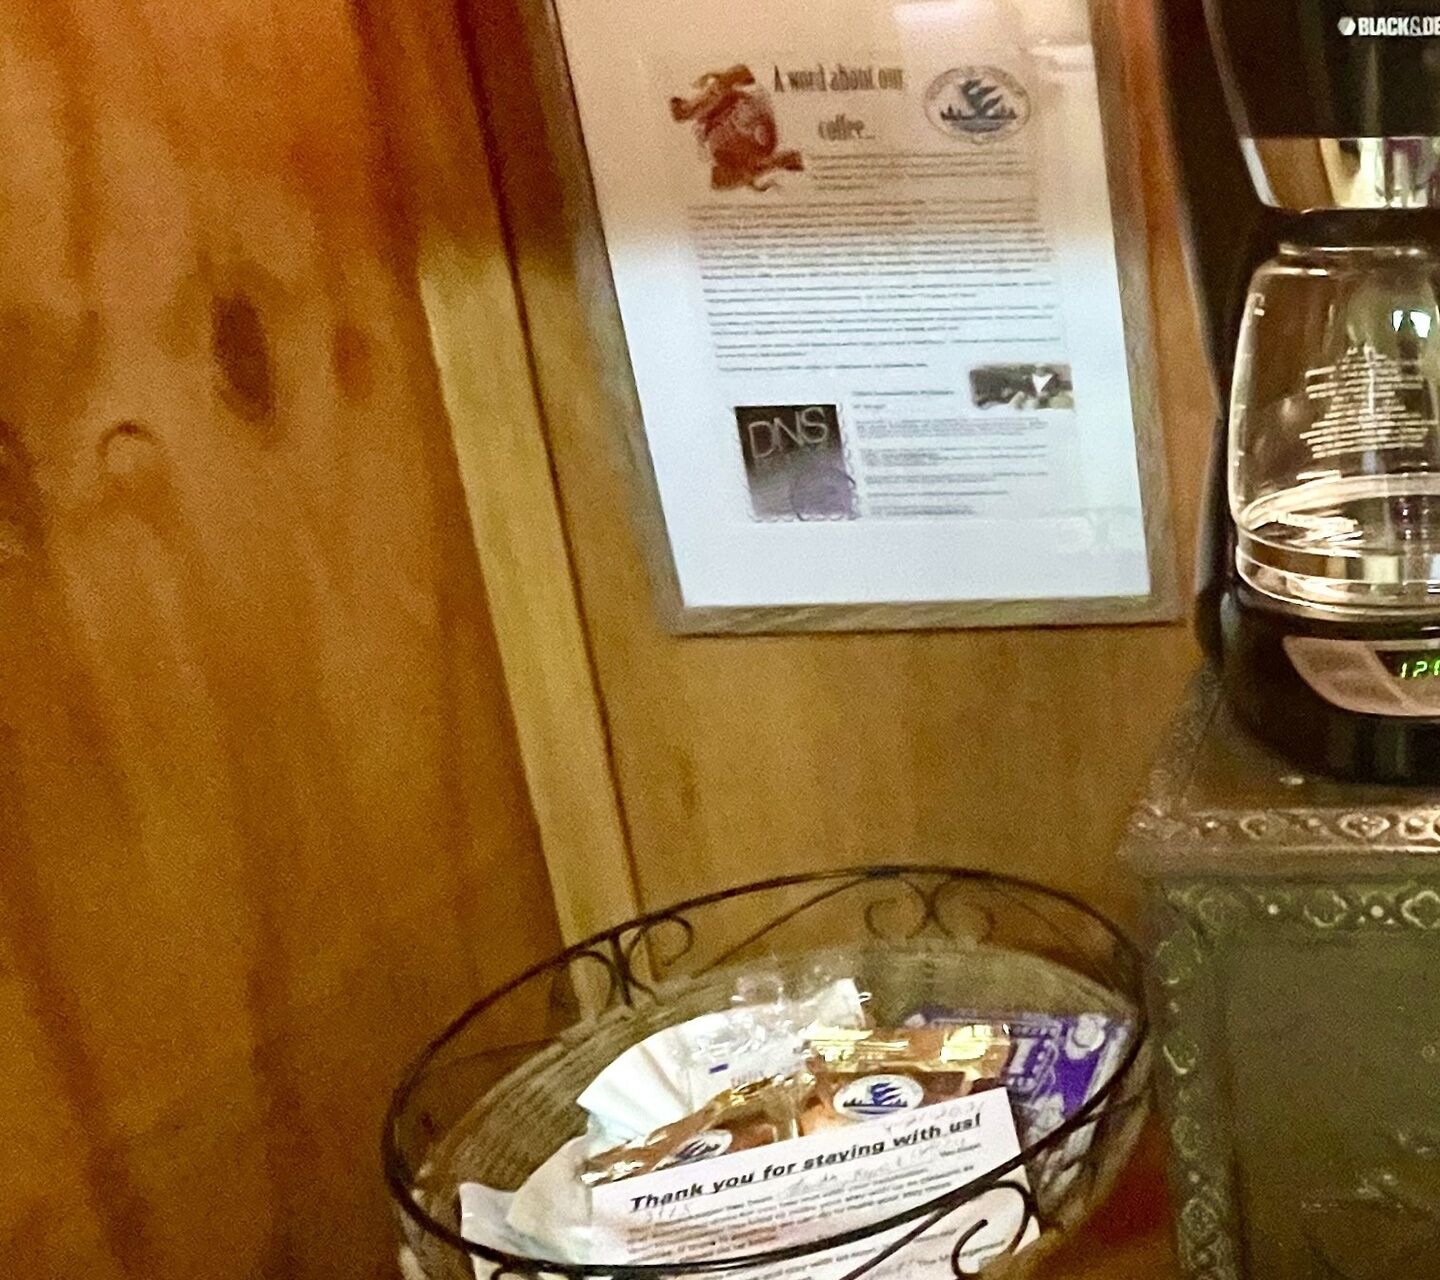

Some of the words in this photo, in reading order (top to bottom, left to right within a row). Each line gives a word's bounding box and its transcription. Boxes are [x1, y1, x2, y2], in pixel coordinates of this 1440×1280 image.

[748, 406, 829, 460] DNS
[630, 1182, 704, 1212] Thank
[711, 1172, 754, 1194] you
[762, 1162, 797, 1181] for
[803, 1138, 886, 1171] staying
[892, 1124, 942, 1147] with
[949, 1112, 982, 1134] us!
